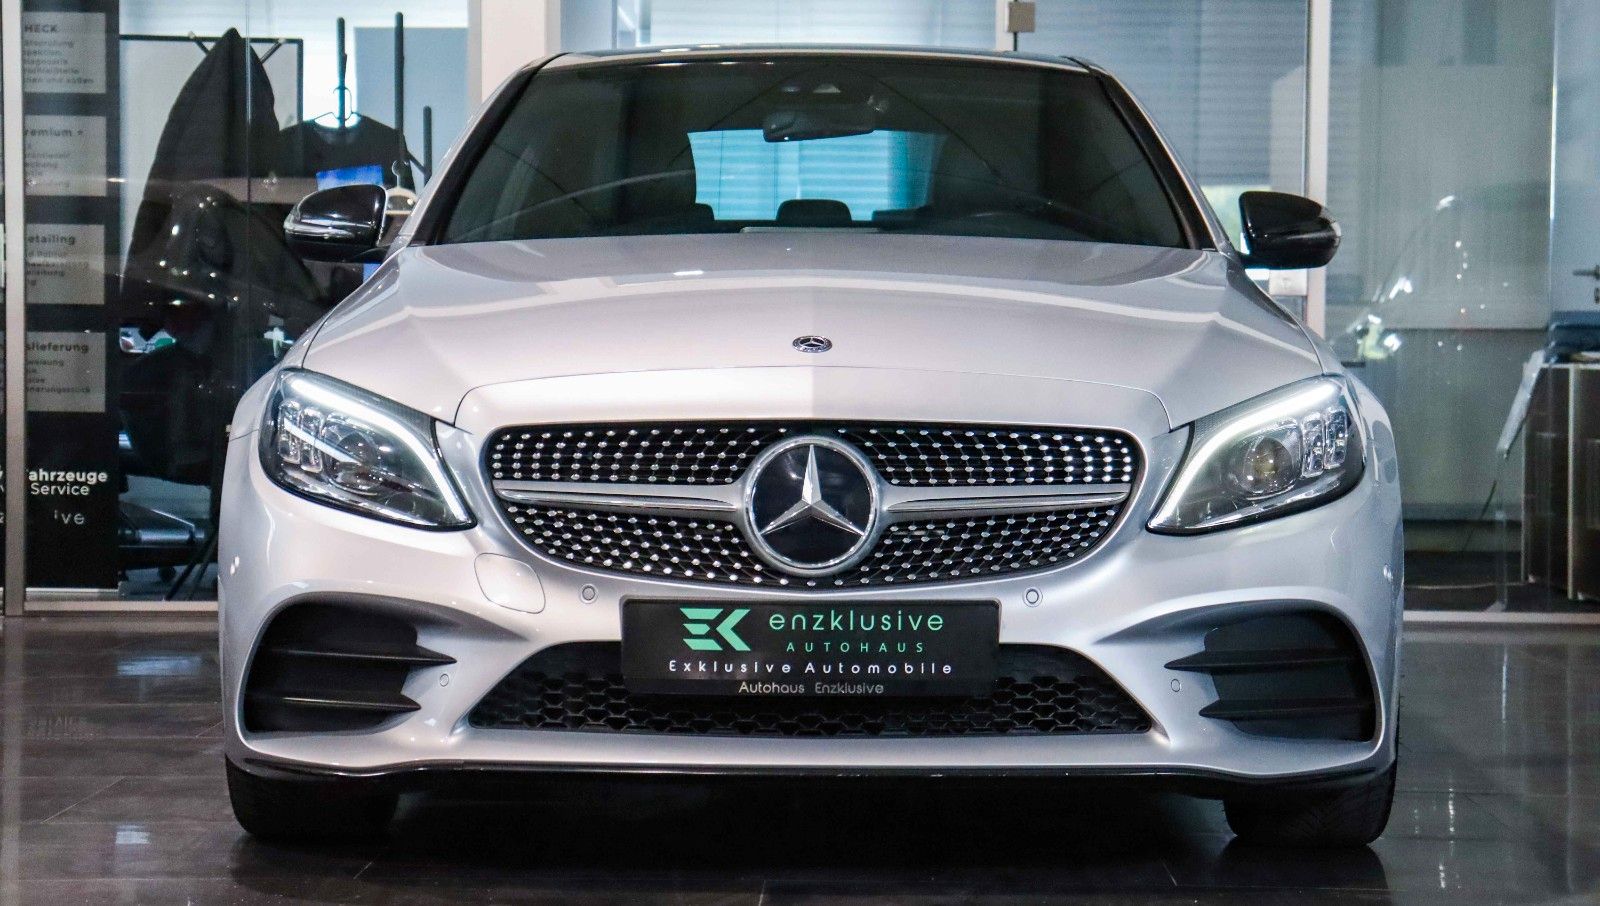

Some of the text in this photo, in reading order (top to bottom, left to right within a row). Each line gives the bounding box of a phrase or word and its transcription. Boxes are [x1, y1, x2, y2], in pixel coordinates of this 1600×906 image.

[30, 483, 90, 496] Service
[769, 609, 944, 631] enzklusive
[786, 642, 924, 653] AUTOHAUS
[669, 660, 952, 674] Exklusive Automobile
[738, 681, 885, 694] Autohaus Enzklusive
